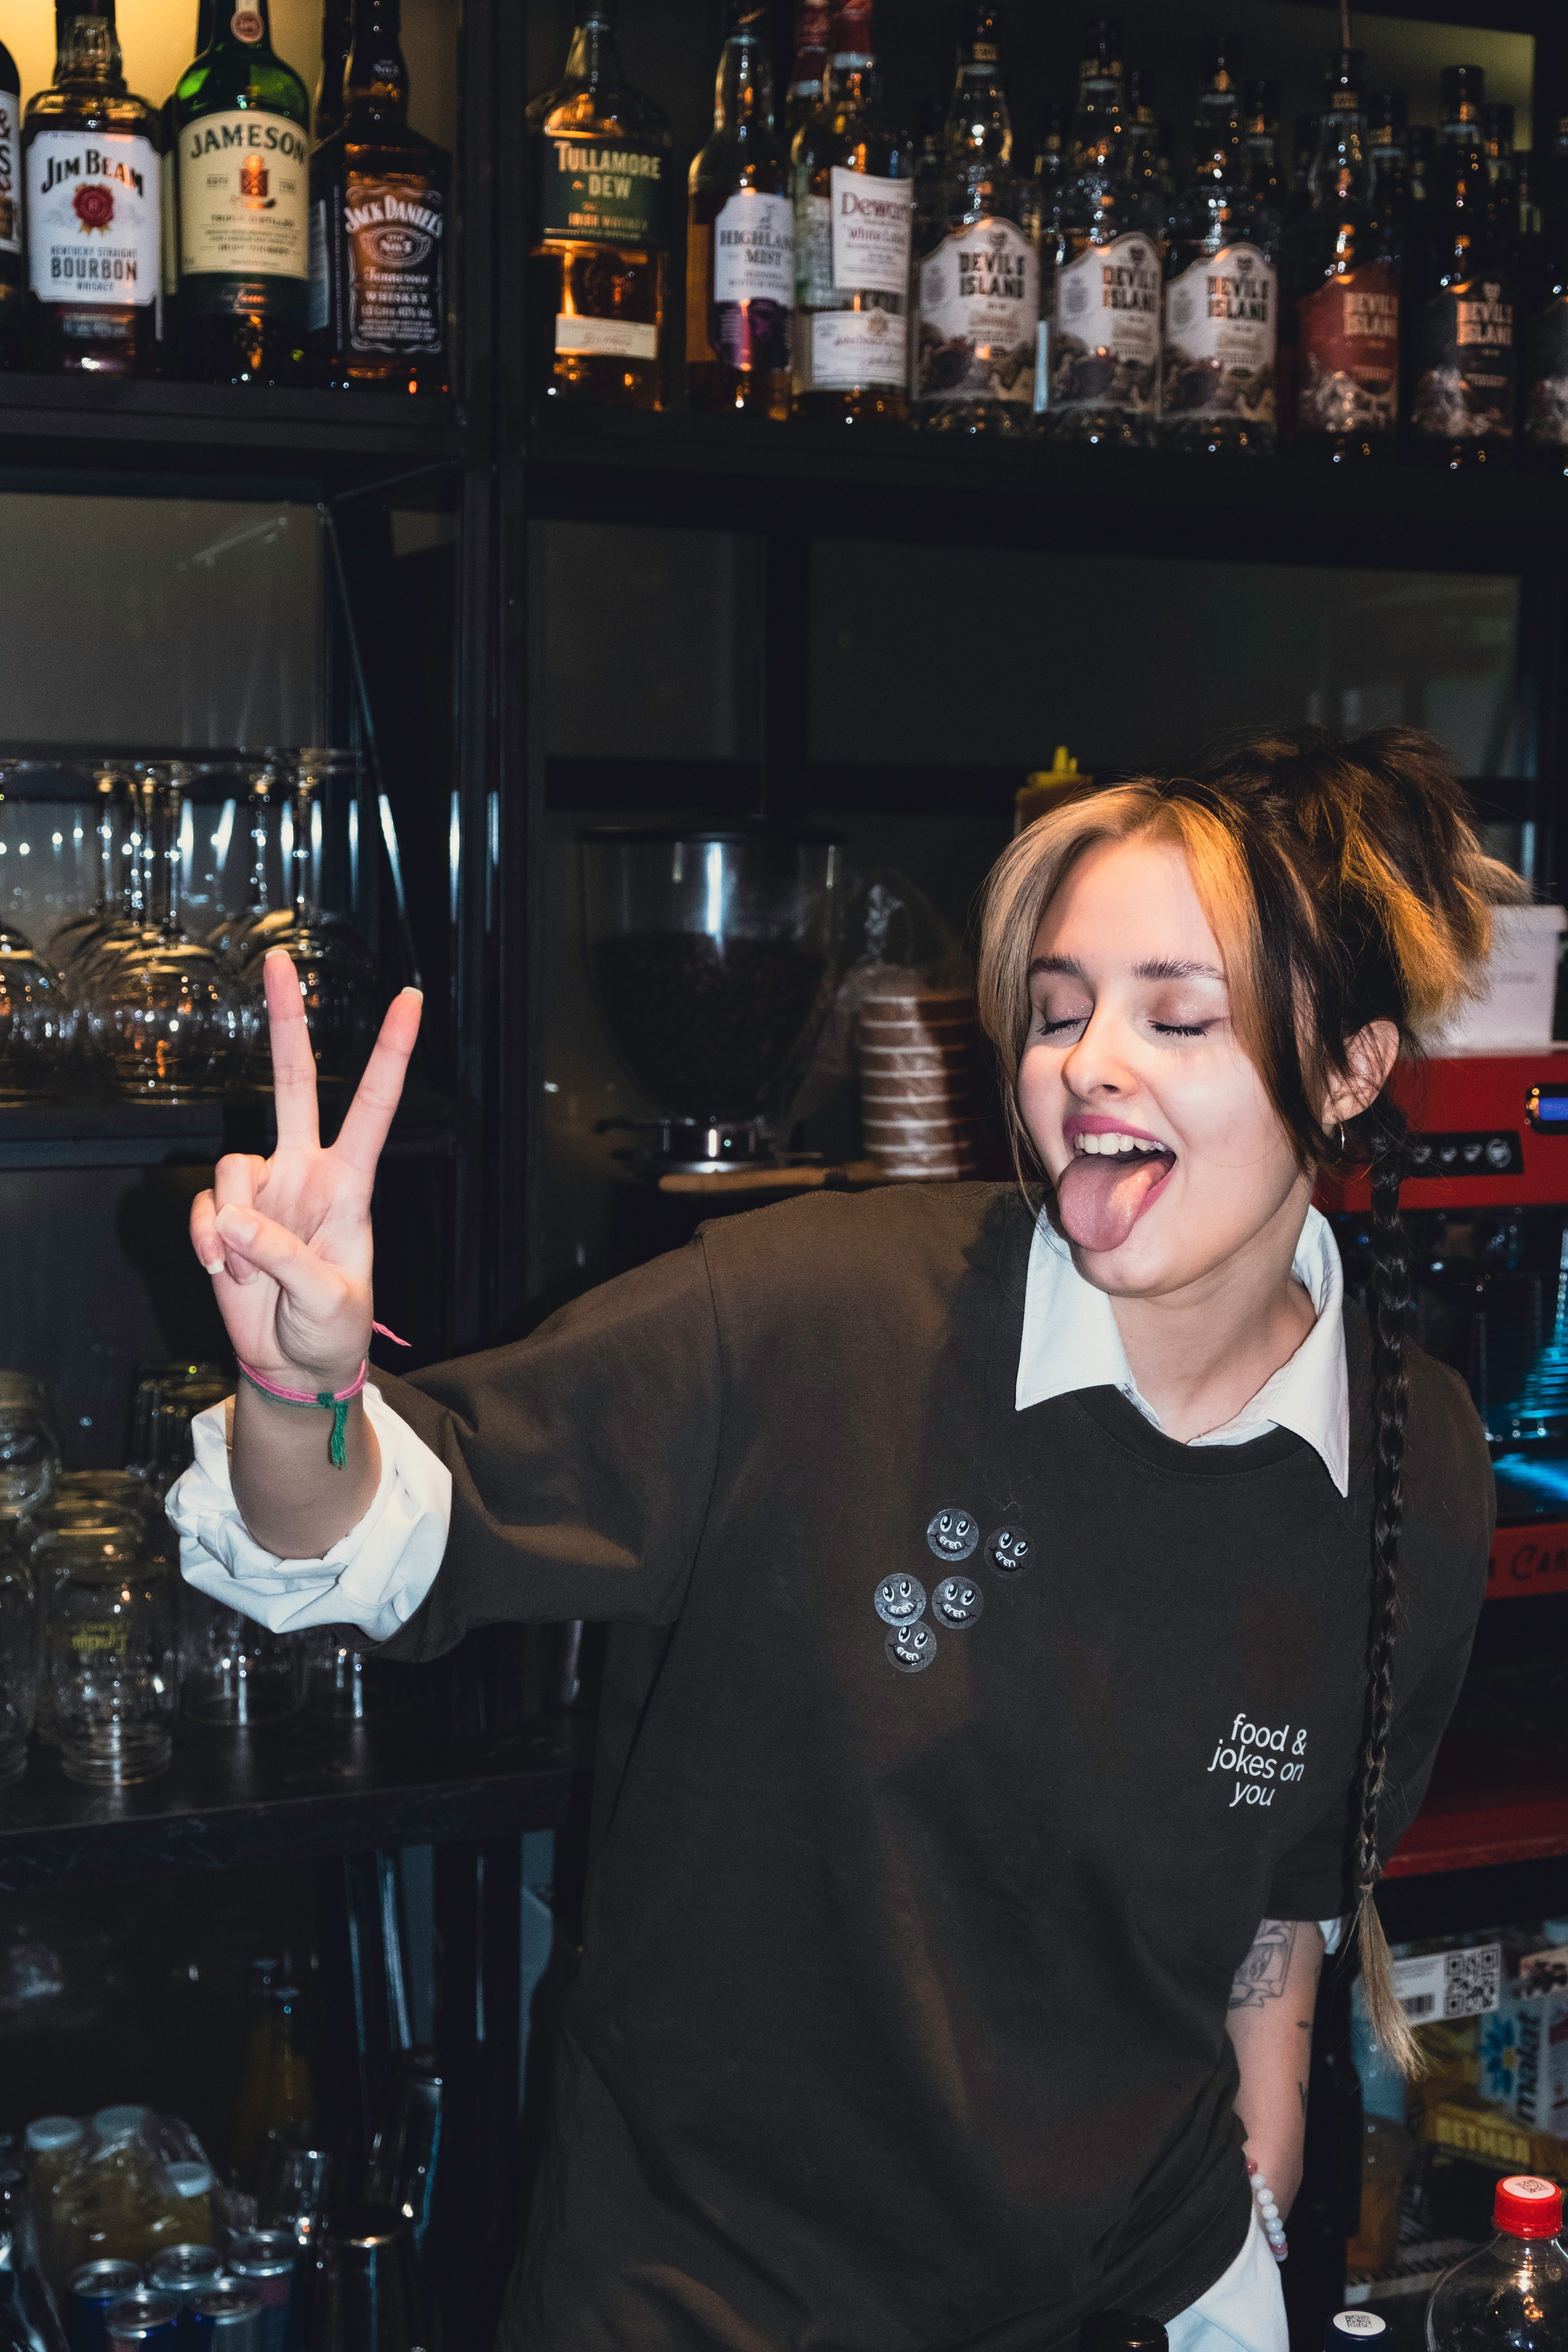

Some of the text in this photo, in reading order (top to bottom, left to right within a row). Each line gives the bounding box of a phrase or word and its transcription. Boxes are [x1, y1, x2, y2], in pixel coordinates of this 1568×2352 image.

[190, 124, 304, 164] JAMESON
[554, 140, 662, 180] TULLAMORE
[40, 156, 80, 194] JIM
[85, 149, 144, 198] BEAM
[589, 174, 632, 199] DEW
[344, 201, 385, 233] JACK
[51, 257, 137, 281] BOURBON
[940, 1536, 962, 1550] eren
[995, 1551, 1016, 1567] eren
[891, 1602, 914, 1613] eren
[944, 1604, 966, 1618] eren
[897, 1646, 919, 1661] eren
[1231, 1713, 1307, 1755] food &
[1207, 1739, 1305, 1782] jokes on
[1229, 1782, 1276, 1807] you
